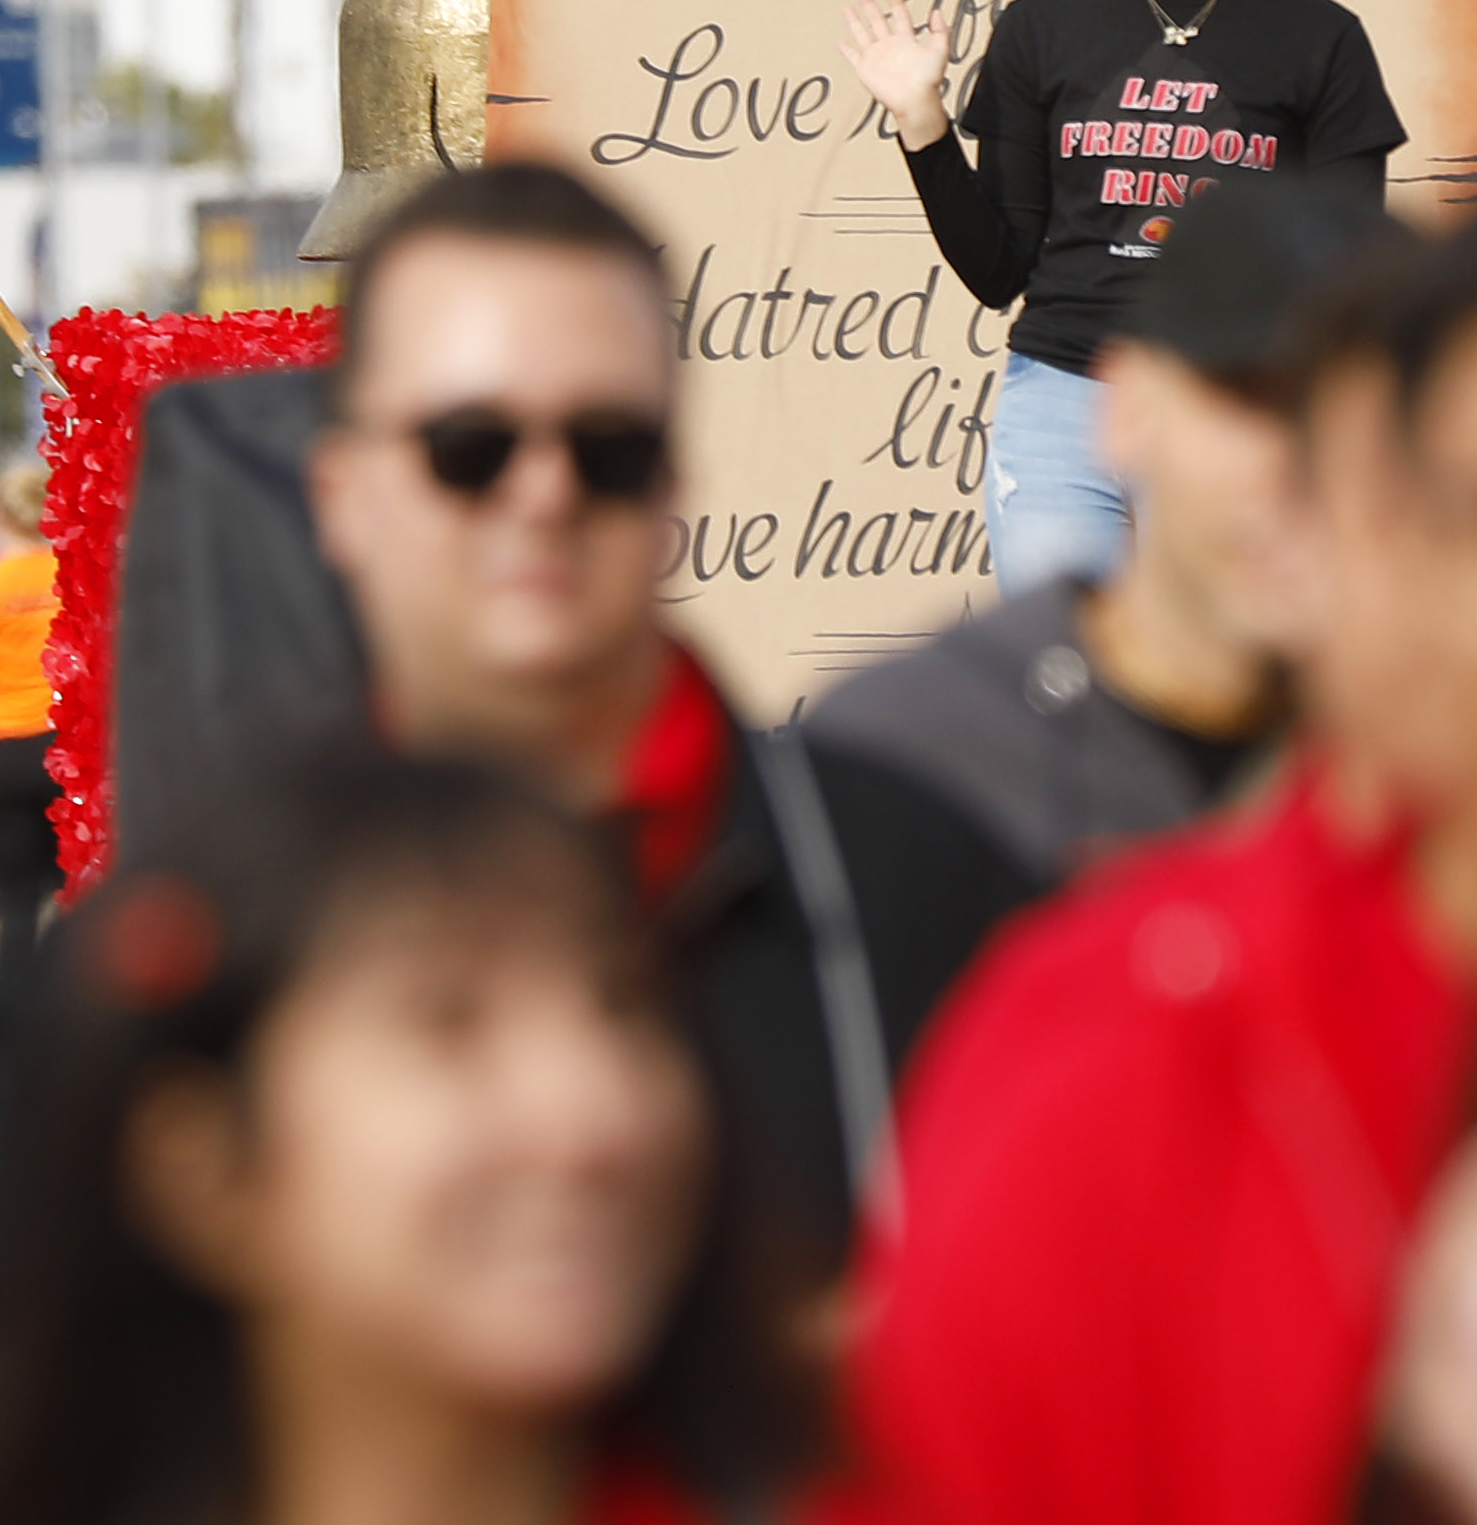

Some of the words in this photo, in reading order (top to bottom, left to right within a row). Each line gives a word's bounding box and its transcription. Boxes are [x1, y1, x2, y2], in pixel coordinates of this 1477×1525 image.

[590, 23, 832, 165] Love
[1119, 77, 1219, 113] LET
[1060, 121, 1278, 172] FREEDOM
[861, 365, 997, 496] lif
